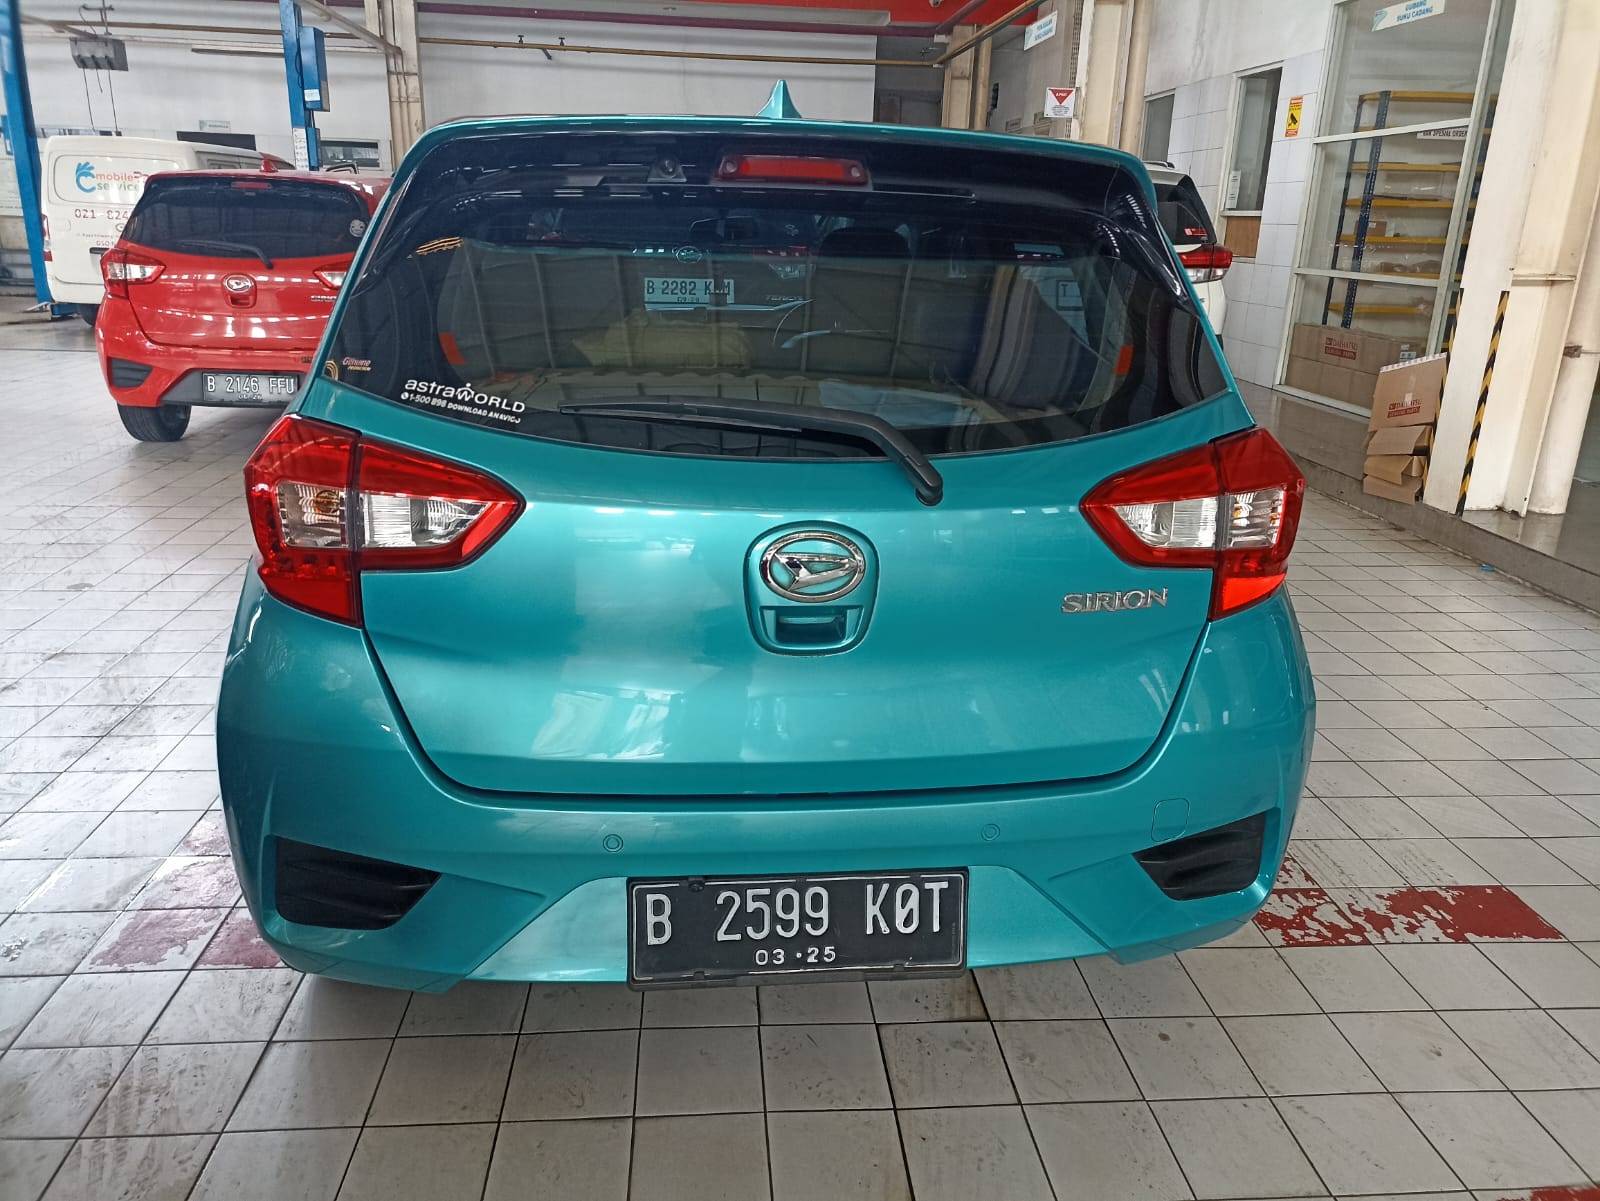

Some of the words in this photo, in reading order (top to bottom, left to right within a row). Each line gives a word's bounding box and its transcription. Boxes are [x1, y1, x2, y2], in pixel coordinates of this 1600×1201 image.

[96, 173, 134, 181] mobile
[74, 208, 96, 219] 021
[646, 280, 656, 295] B
[661, 280, 697, 296] 2282
[207, 376, 216, 392] B
[226, 377, 260, 393] 2146
[269, 378, 295, 395] FFU
[409, 393, 431, 405] 1-500
[447, 402, 488, 417] DOWNLOAD
[1062, 588, 1169, 613] SIRION
[646, 893, 672, 945] B
[716, 886, 829, 942] 2599
